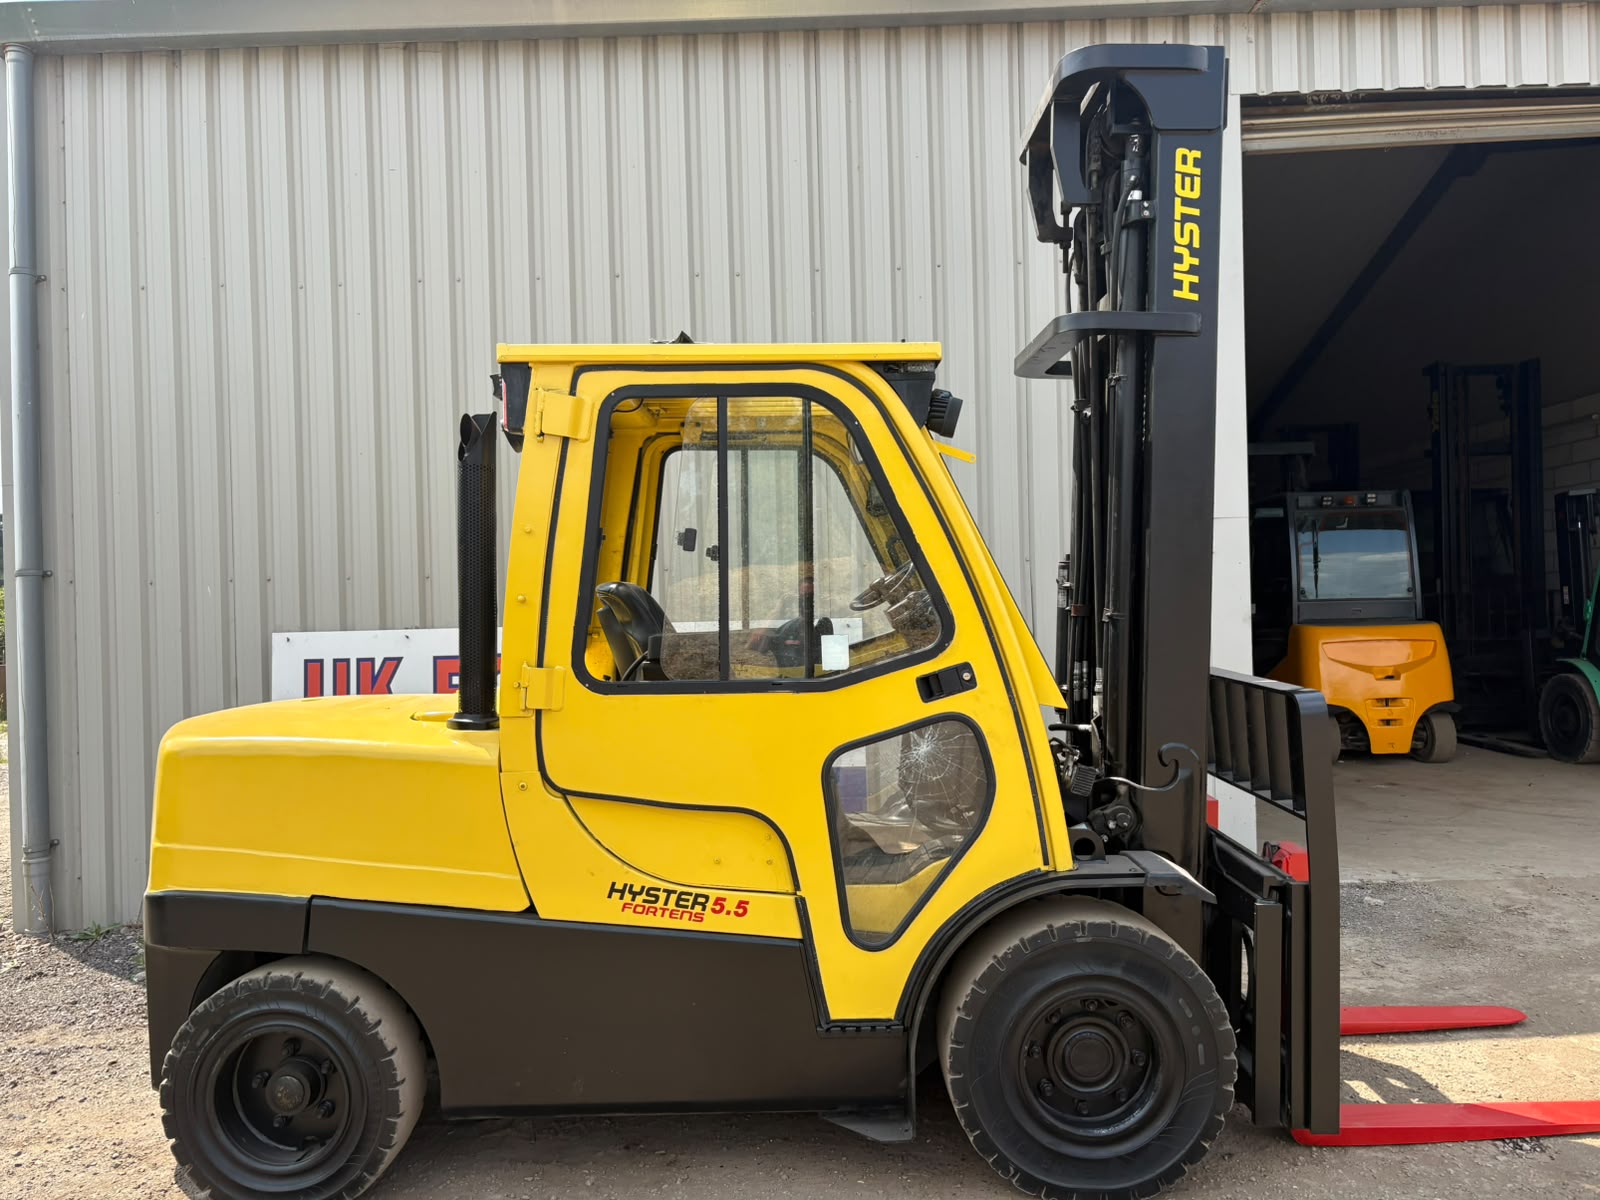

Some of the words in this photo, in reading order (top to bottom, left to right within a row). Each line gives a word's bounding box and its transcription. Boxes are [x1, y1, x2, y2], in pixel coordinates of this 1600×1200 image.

[1172, 147, 1201, 301] HYSTER
[607, 882, 710, 911] HYSTER
[710, 896, 750, 917] 5.5
[621, 902, 705, 922] FORTENS
